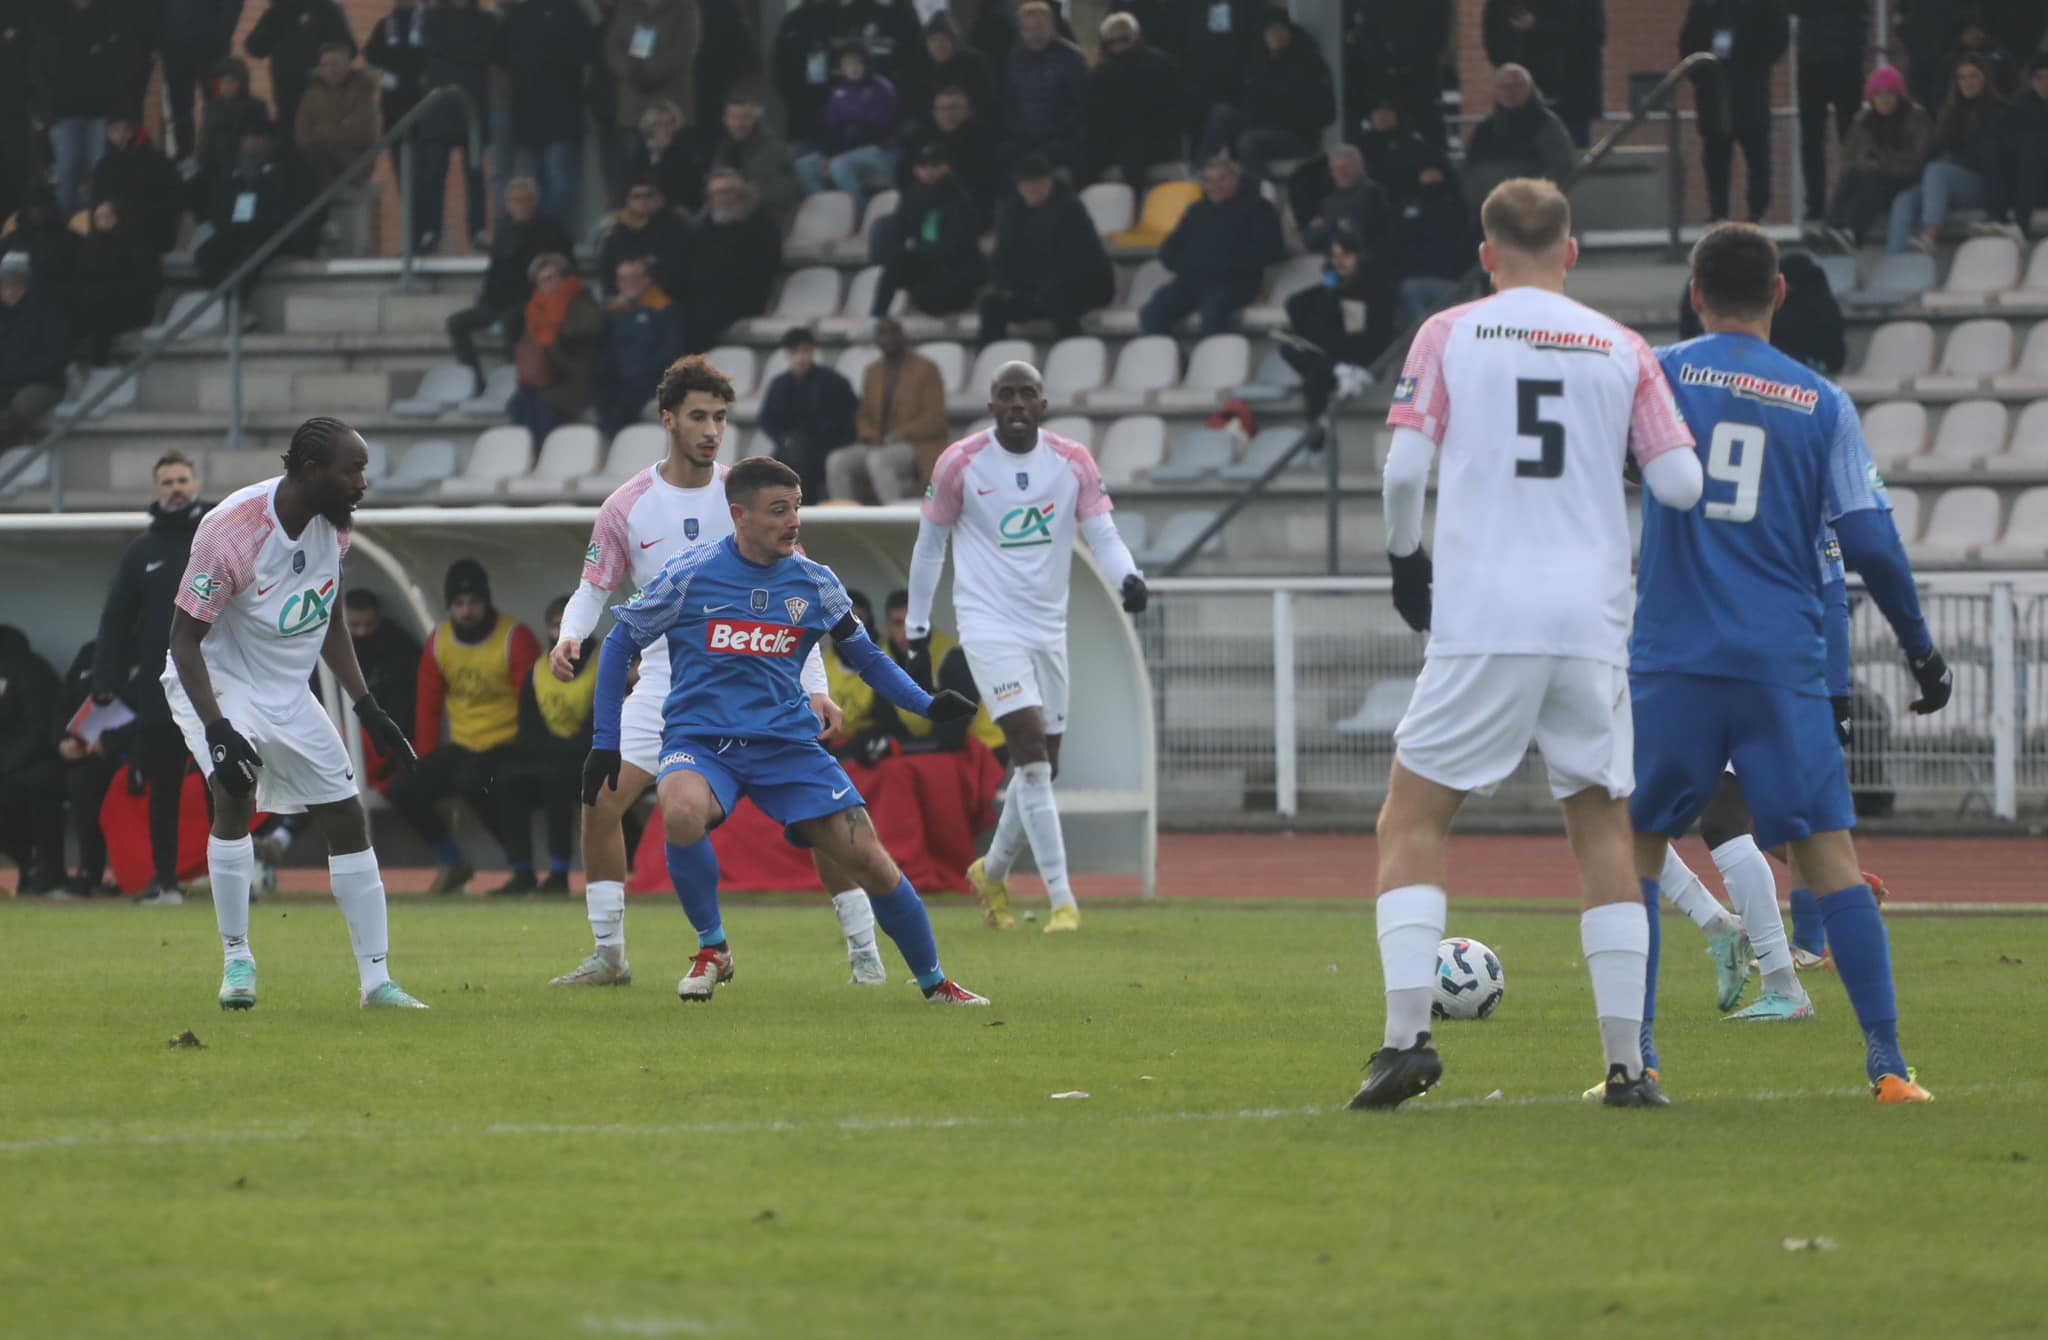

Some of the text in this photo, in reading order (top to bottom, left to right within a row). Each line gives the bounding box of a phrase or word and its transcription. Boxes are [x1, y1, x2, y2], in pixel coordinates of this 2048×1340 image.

[1514, 377, 1566, 480] 5
[1704, 420, 1766, 523] 9
[710, 623, 797, 654] Betclic
